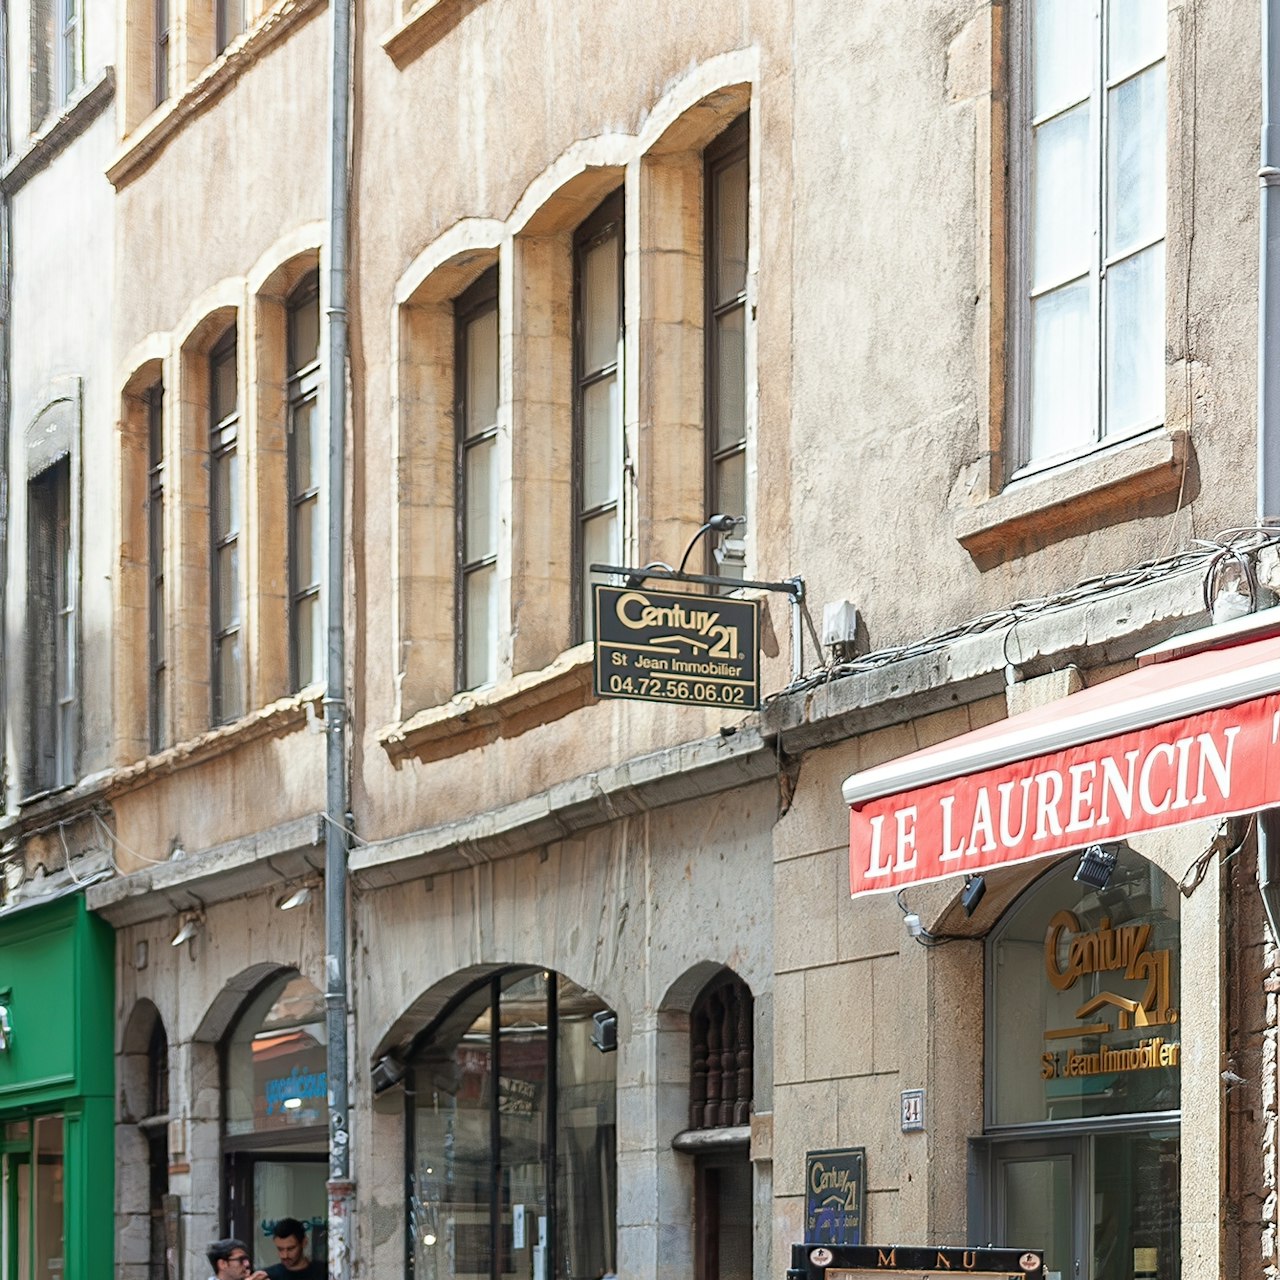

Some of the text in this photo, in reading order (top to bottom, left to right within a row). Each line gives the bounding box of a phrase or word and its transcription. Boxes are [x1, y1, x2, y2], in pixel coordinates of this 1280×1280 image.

[616, 592, 719, 635] Century
[708, 624, 738, 660] 21
[611, 651, 742, 677] St Jean Immobilier
[610, 675, 744, 704] 04.72.56.06.02
[863, 806, 918, 880] LE
[938, 725, 1242, 863] LAURENCIN
[1045, 909, 1151, 990] Century
[1041, 1052, 1060, 1079] St
[1063, 1047, 1099, 1077] Jean
[904, 1100, 919, 1121] 24
[811, 1161, 849, 1194] Century
